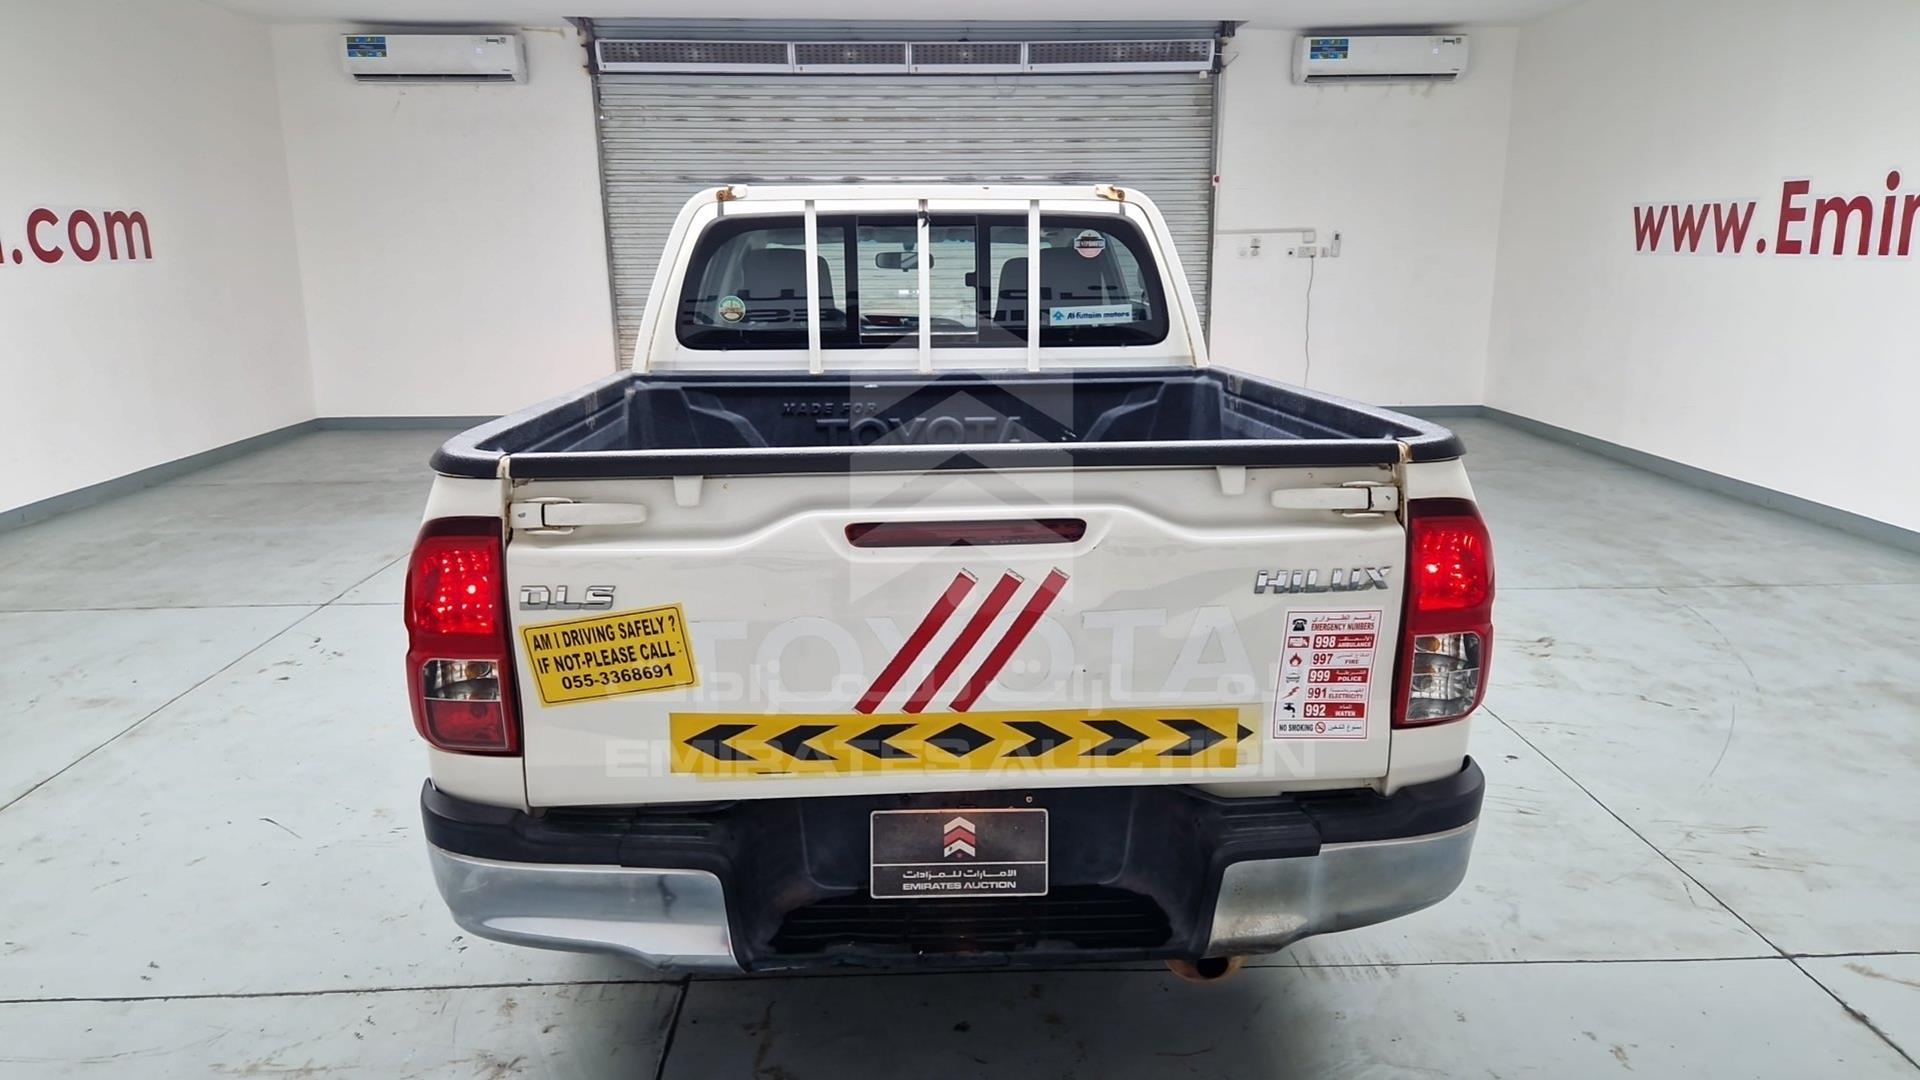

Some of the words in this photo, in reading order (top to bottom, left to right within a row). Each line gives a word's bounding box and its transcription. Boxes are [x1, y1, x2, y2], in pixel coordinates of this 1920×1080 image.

[0, 208, 152, 264] .com
[783, 402, 833, 414] MADE
[842, 402, 877, 414] FOR
[1254, 566, 1392, 594] HILUX
[519, 585, 616, 611] DLS
[1311, 623, 1346, 631] EMERGENCY
[1347, 622, 1375, 631] NUMBERS
[532, 633, 553, 652] AM
[554, 633, 561, 649] I
[561, 623, 616, 648] DRIVING
[619, 614, 665, 640] SAFELY
[1314, 636, 1336, 648] 998
[537, 657, 550, 674] IF
[553, 645, 638, 673] NOT-PLEASE
[639, 640, 676, 661] CALL
[1312, 653, 1333, 665] 997
[562, 662, 674, 690] 055-3368691
[1309, 670, 1331, 682] 999
[1307, 687, 1328, 699] 991
[1305, 704, 1326, 716] 992
[902, 881, 962, 891] EMIRATES
[963, 881, 1017, 890] AUCTION
